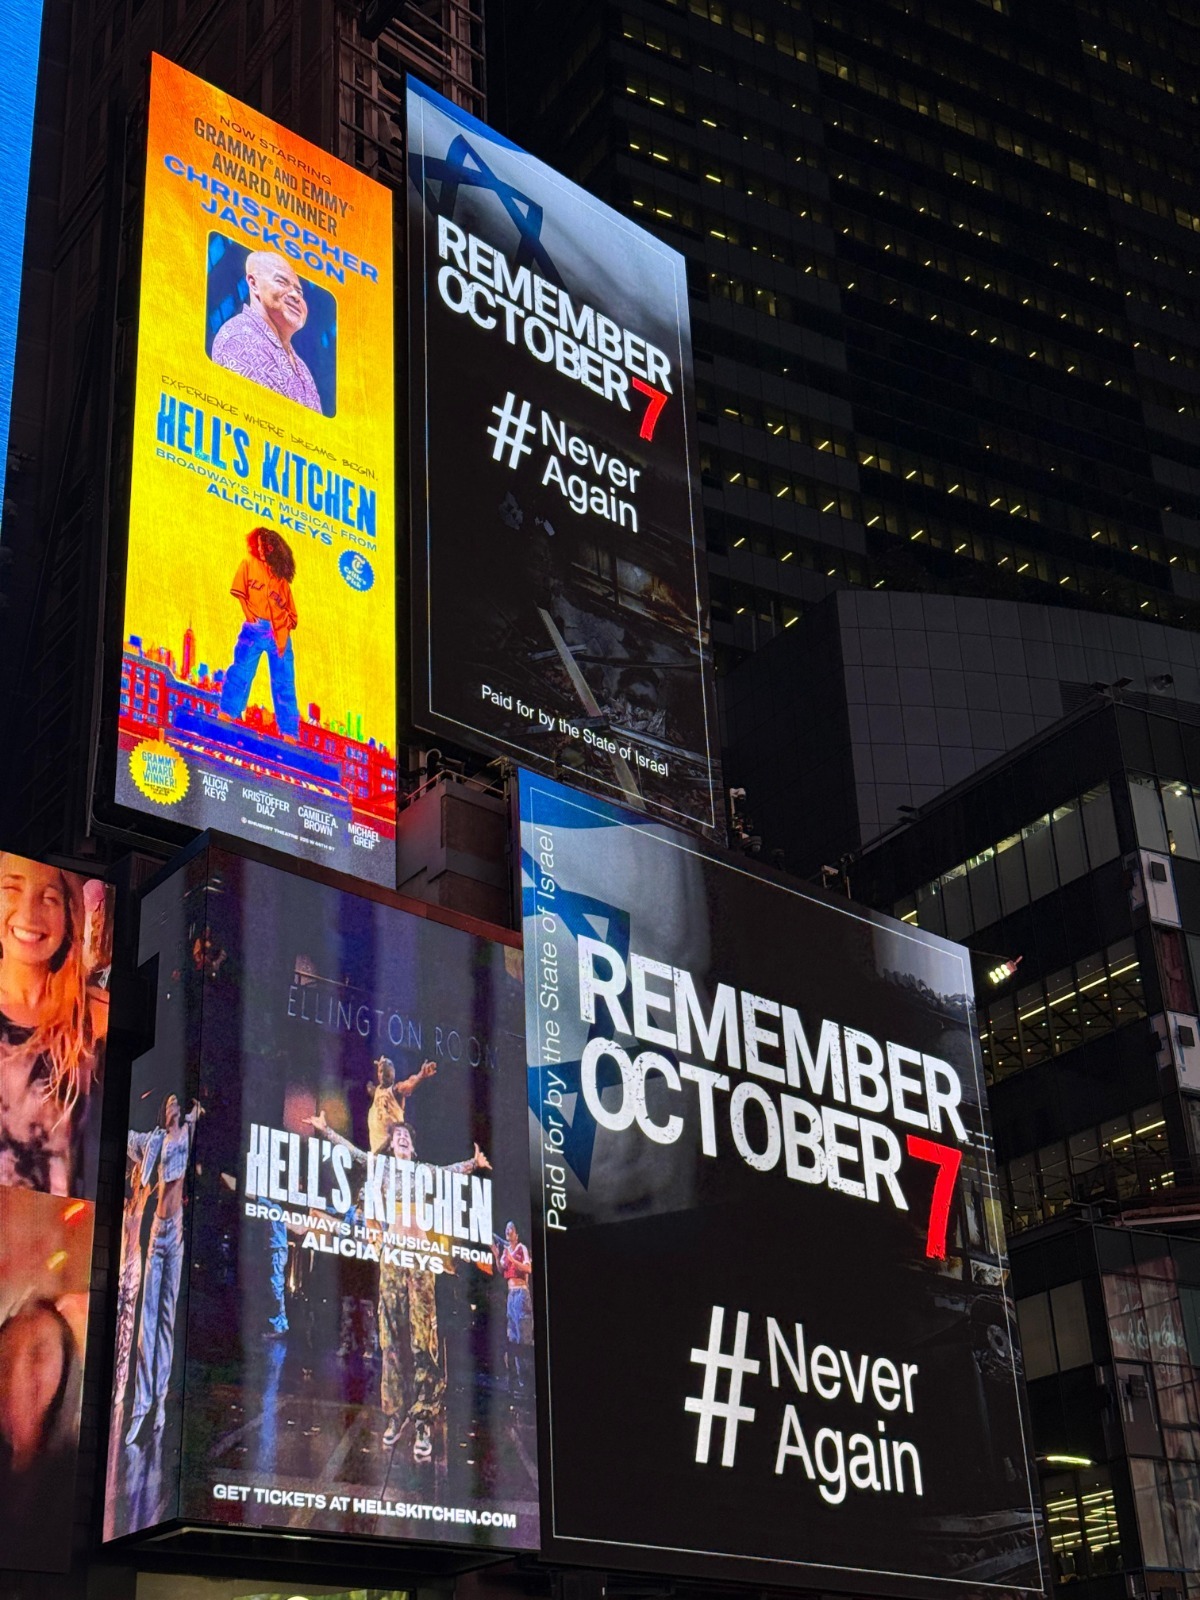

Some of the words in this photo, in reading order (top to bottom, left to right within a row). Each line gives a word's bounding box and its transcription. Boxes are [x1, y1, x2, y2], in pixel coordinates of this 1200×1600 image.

[219, 115, 255, 141] NOW
[259, 137, 332, 186] STARRING
[273, 167, 298, 190] AND
[163, 154, 379, 283] CHRISTOPHER
[212, 152, 271, 199] AWARD
[274, 184, 338, 237] WINNER
[201, 198, 346, 284] JACKSON
[438, 214, 673, 394] REMEMBER
[438, 265, 631, 412] OCTOBER
[632, 376, 668, 442] 7
[161, 375, 239, 416] EXPERIENCE
[243, 412, 285, 438] WHERE
[290, 433, 337, 462] DREAMS
[156, 391, 250, 478] HELL'S
[262, 441, 376, 538] KITCHEN
[541, 409, 640, 495] Never
[156, 447, 249, 495] BROADWAY'S
[253, 490, 275, 506] HIT
[279, 502, 338, 535] MUSICAL
[341, 531, 378, 552] FROM
[206, 483, 275, 521] ALICIA
[279, 514, 333, 546] KEYS
[541, 455, 639, 533] Again
[142, 751, 178, 768] GRAMMY
[481, 684, 512, 711] Paid
[516, 701, 534, 719] for
[539, 708, 555, 729] by
[559, 718, 580, 739] the
[583, 728, 616, 754] State
[619, 745, 632, 761] of
[635, 751, 669, 777] Israel
[146, 761, 174, 778] AWARD
[202, 775, 229, 792] ALICIA
[204, 785, 226, 802] KEYS
[242, 787, 290, 813] KRISTOFFER
[256, 802, 275, 818] DIAZ
[298, 806, 330, 826] CAMILLE
[331, 817, 339, 829] A.
[304, 818, 333, 837] BROWN
[347, 822, 381, 843] MICHAEL
[353, 835, 376, 850] GREIF
[535, 827, 556, 900] Israel
[537, 905, 556, 933] of
[540, 942, 559, 1011] State
[287, 985, 422, 1050] ELLINGTON
[542, 1020, 561, 1063] the
[577, 934, 968, 1142] REMEMBER
[544, 1071, 567, 1109] by
[545, 1115, 565, 1155] for
[580, 1036, 909, 1211] OCTOBER
[906, 1134, 962, 1261] 7
[245, 1123, 352, 1213] HELL'S
[364, 1151, 493, 1247] KITCHEN
[545, 1164, 567, 1231] Paid
[245, 1202, 351, 1237] BROADWAY'S
[354, 1224, 380, 1241] HIT
[383, 1230, 449, 1256] MUSICAL
[452, 1244, 493, 1265] FROM
[301, 1231, 380, 1263] ALICIA
[384, 1246, 444, 1275] KEYS
[766, 1316, 919, 1414] Never
[775, 1404, 923, 1505] Again
[213, 1484, 252, 1502] GET
[253, 1488, 326, 1509] TICKETS
[329, 1496, 350, 1512] AT
[353, 1498, 517, 1529] HELLSKITCHEN.COM
